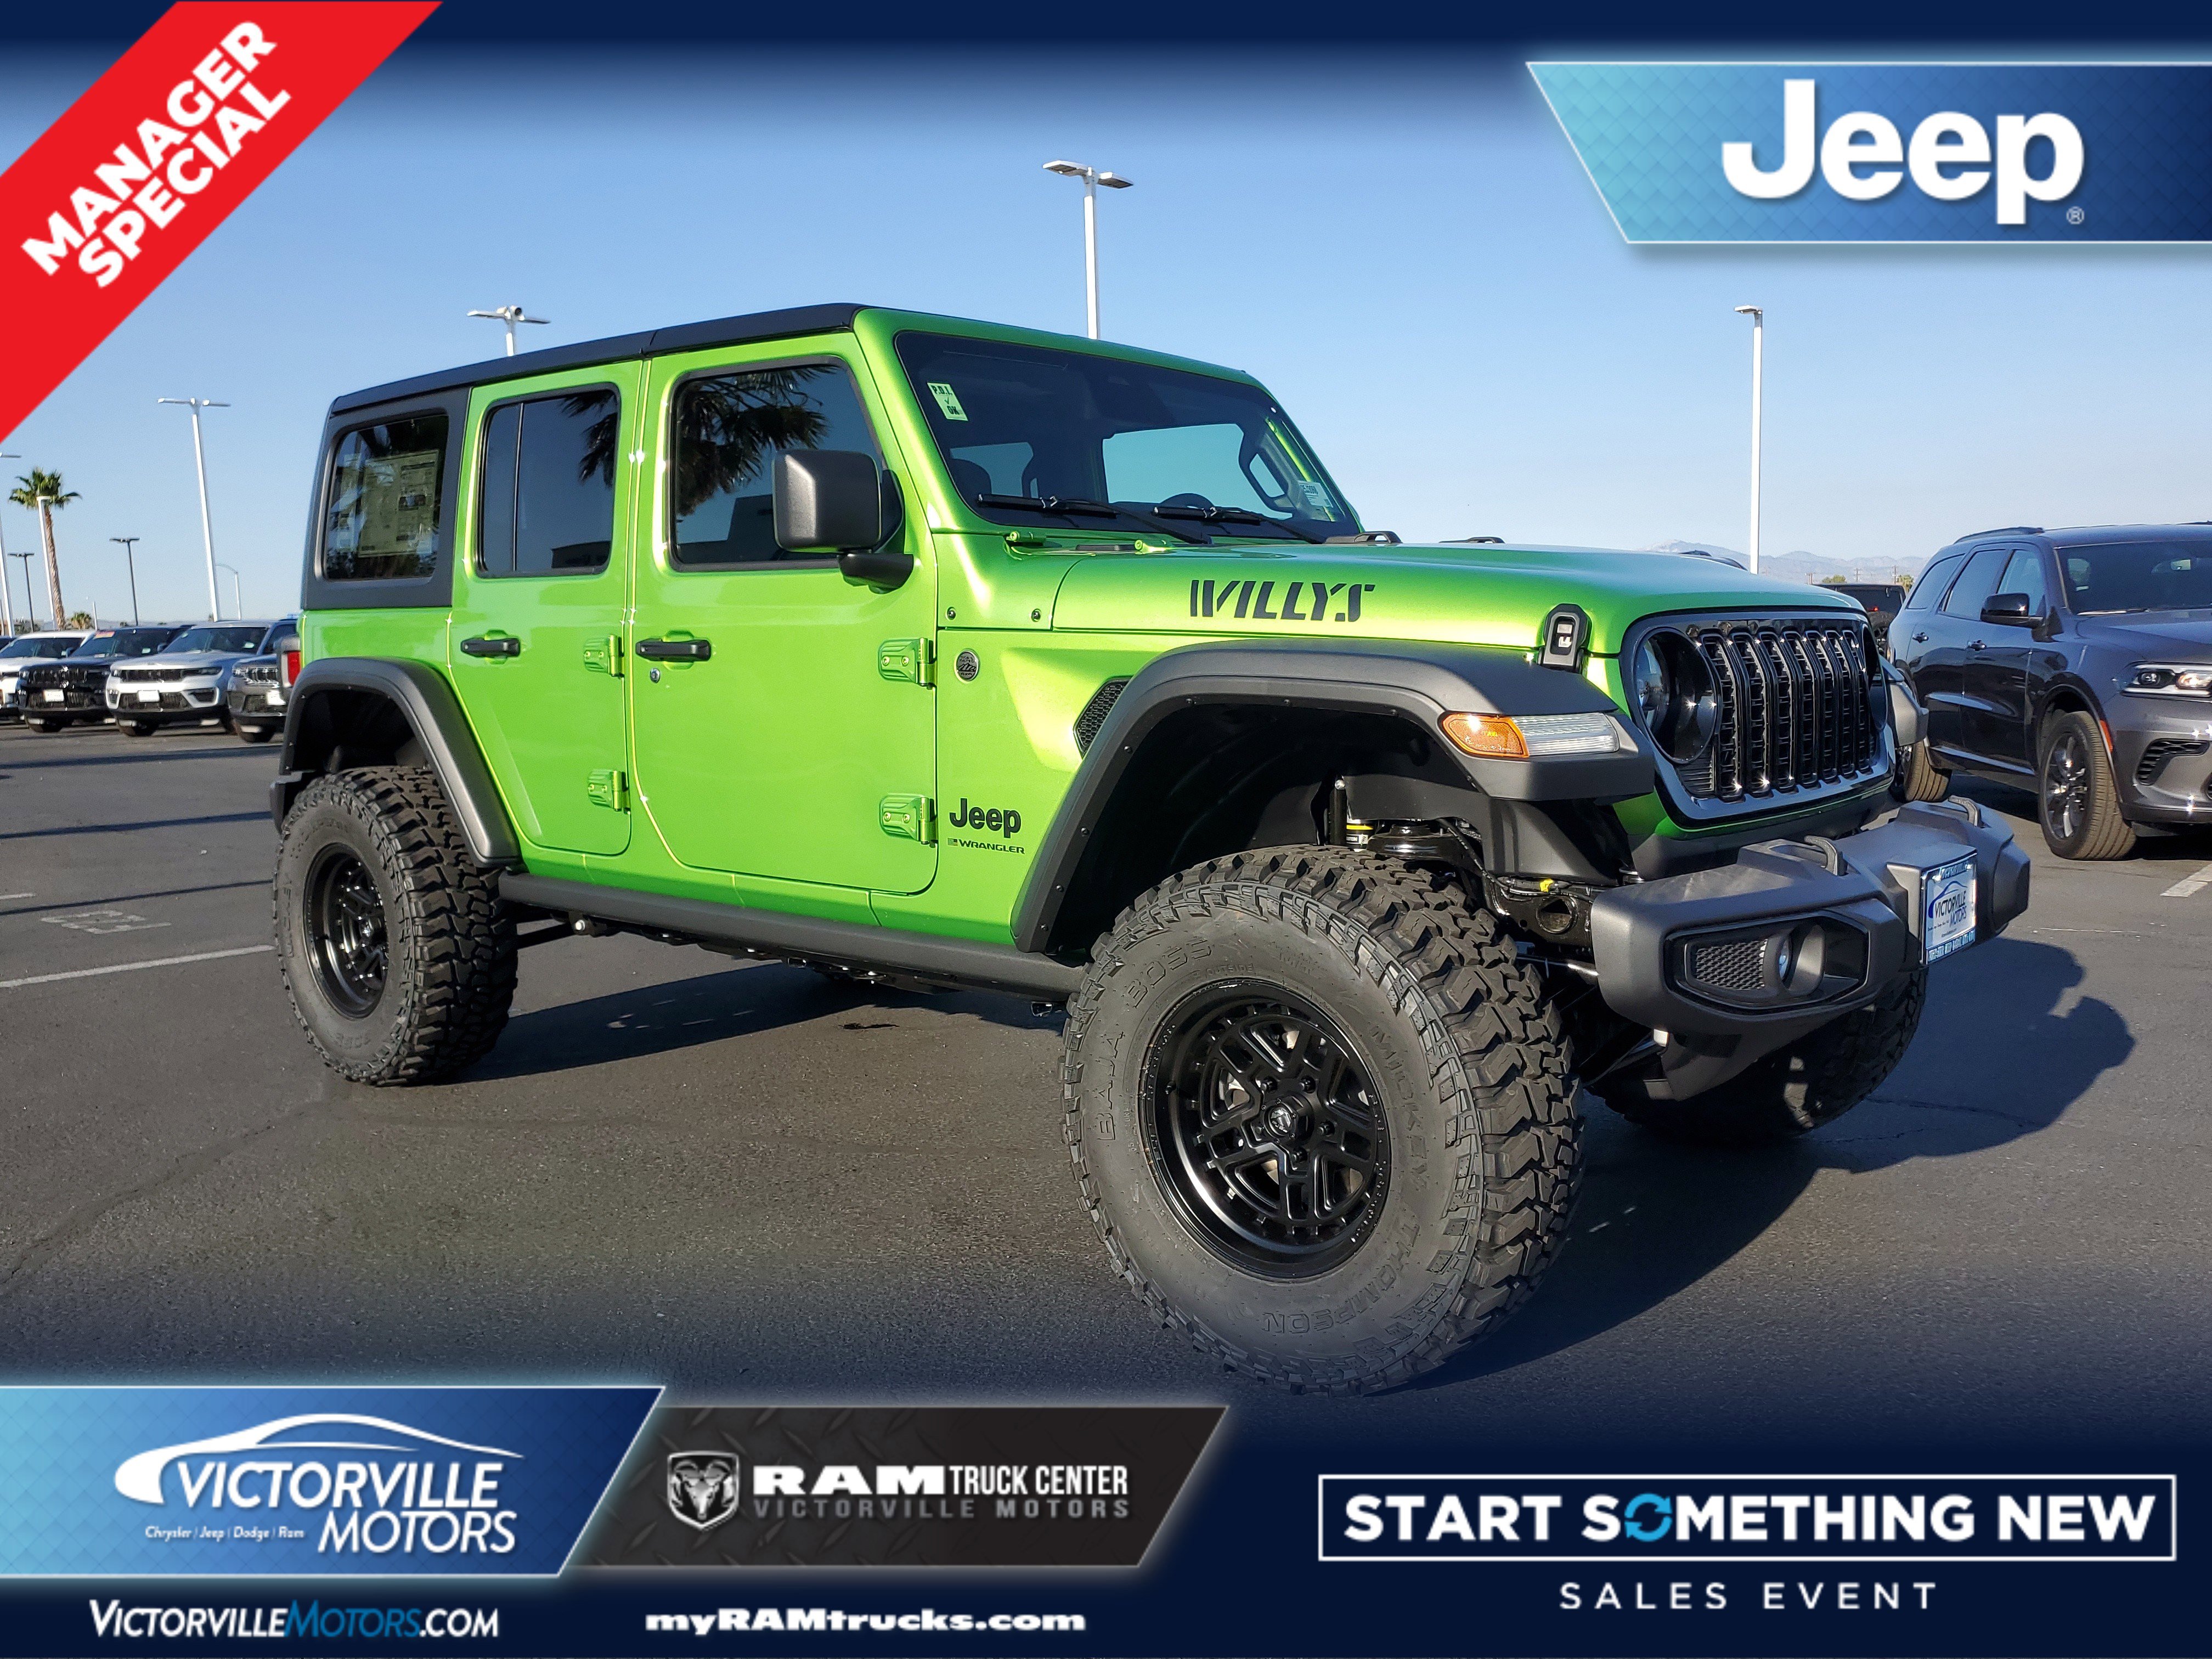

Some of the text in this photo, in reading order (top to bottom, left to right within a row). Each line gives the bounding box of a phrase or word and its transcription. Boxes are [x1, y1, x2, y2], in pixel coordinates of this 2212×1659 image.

[1190, 580, 1375, 622] WILLYS
[949, 798, 1022, 838] Jeep
[958, 839, 1025, 854] WRANGLER
[1935, 890, 1966, 918] VICTORVILLE
[1949, 905, 1967, 927] MOTORS
[1097, 938, 1212, 1141] BAJA BOSS
